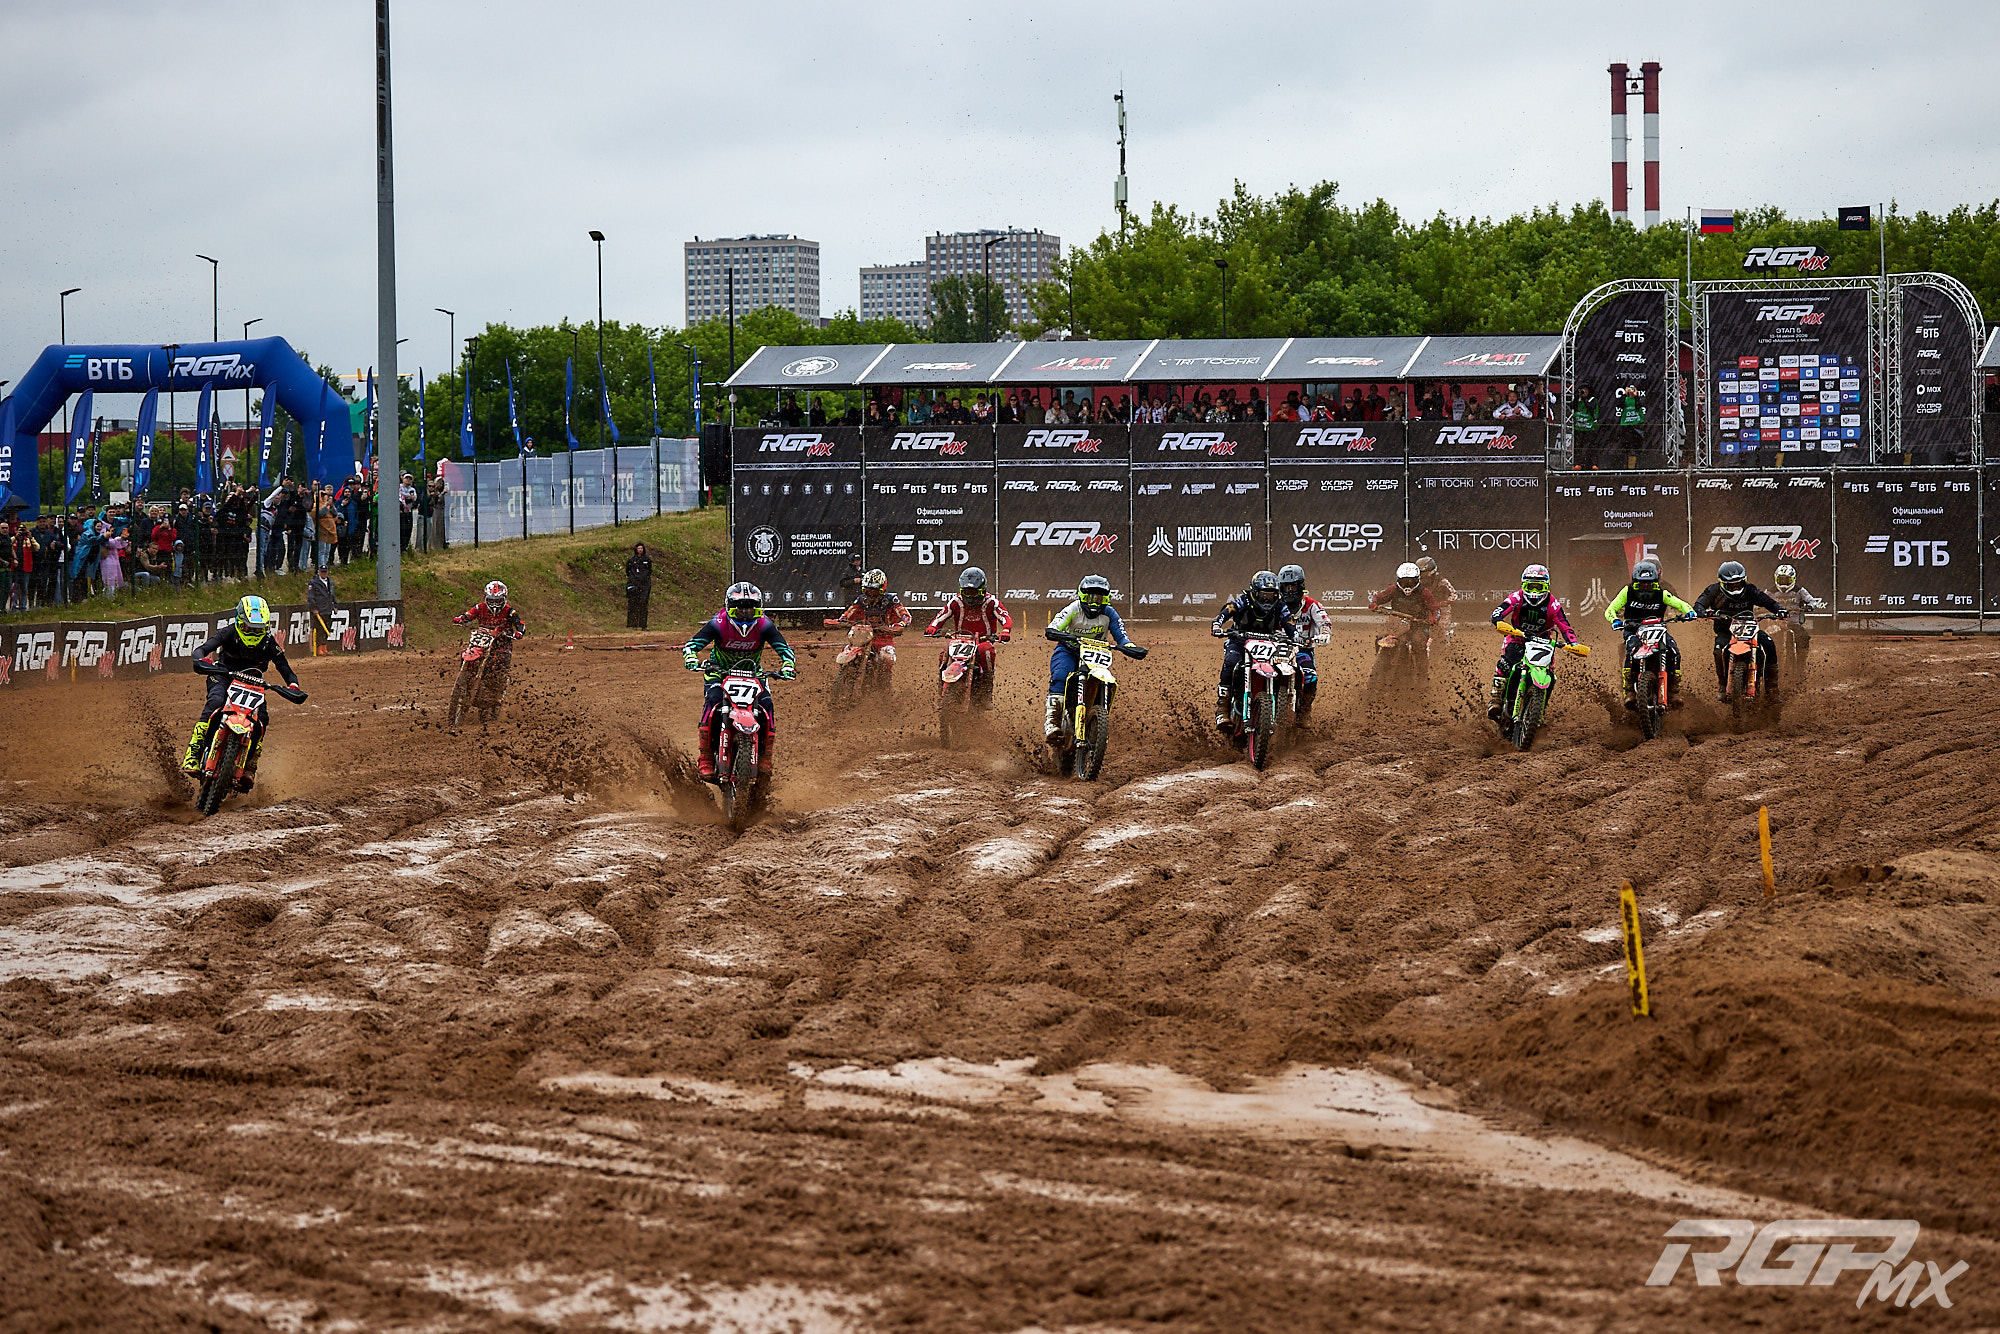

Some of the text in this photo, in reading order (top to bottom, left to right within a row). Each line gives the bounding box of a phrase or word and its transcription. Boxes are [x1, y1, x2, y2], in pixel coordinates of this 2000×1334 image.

[1923, 328, 1940, 338] ВТБ
[1624, 333, 1645, 343] ВТБ
[88, 358, 134, 380] ВТБ
[1441, 478, 1474, 488] TOCHKI
[1506, 478, 1539, 487] TOCHKI
[880, 486, 896, 494] ВТБ
[910, 486, 927, 494] ВТБ
[940, 485, 958, 494] ВТБ
[971, 485, 988, 494] ВТБ
[1564, 488, 1582, 496] ВТБ
[1596, 487, 1614, 496] ВТБ
[1629, 486, 1647, 496] ВТБ
[1662, 486, 1680, 495] ВТБ
[1851, 484, 1870, 493] ВТБ
[1885, 484, 1903, 492] ВТБ
[1918, 483, 1936, 492] ВТБ
[1952, 483, 1970, 492] ВТБ
[916, 508, 963, 516] Официальный
[1604, 510, 1654, 519] Официальный
[1892, 506, 1944, 516] Официальный
[1604, 521, 1632, 529] спонсор
[1892, 518, 1922, 526] спонсор
[1177, 523, 1252, 541] МОСКОВСКИЙ
[1292, 524, 1383, 538] VK ПРО
[1432, 529, 1540, 550] TRI TOCHKI
[1177, 542, 1213, 557] СПОРТ
[1292, 538, 1384, 552] СПОРТ
[791, 548, 818, 556] СПОРТА
[917, 540, 970, 565] ВТБ
[1893, 540, 1950, 567] ВТБ
[1853, 597, 1872, 605] ВТБ
[1887, 596, 1905, 605] ВТБ
[1921, 596, 1939, 605] ВТБ
[1954, 596, 1973, 605] ВТБ
[1250, 644, 1273, 656] 421
[1530, 646, 1551, 662] 7
[1082, 651, 1111, 667] 212
[0, 655, 12, 684] X
[728, 685, 758, 699] 571
[229, 687, 263, 709] 717
